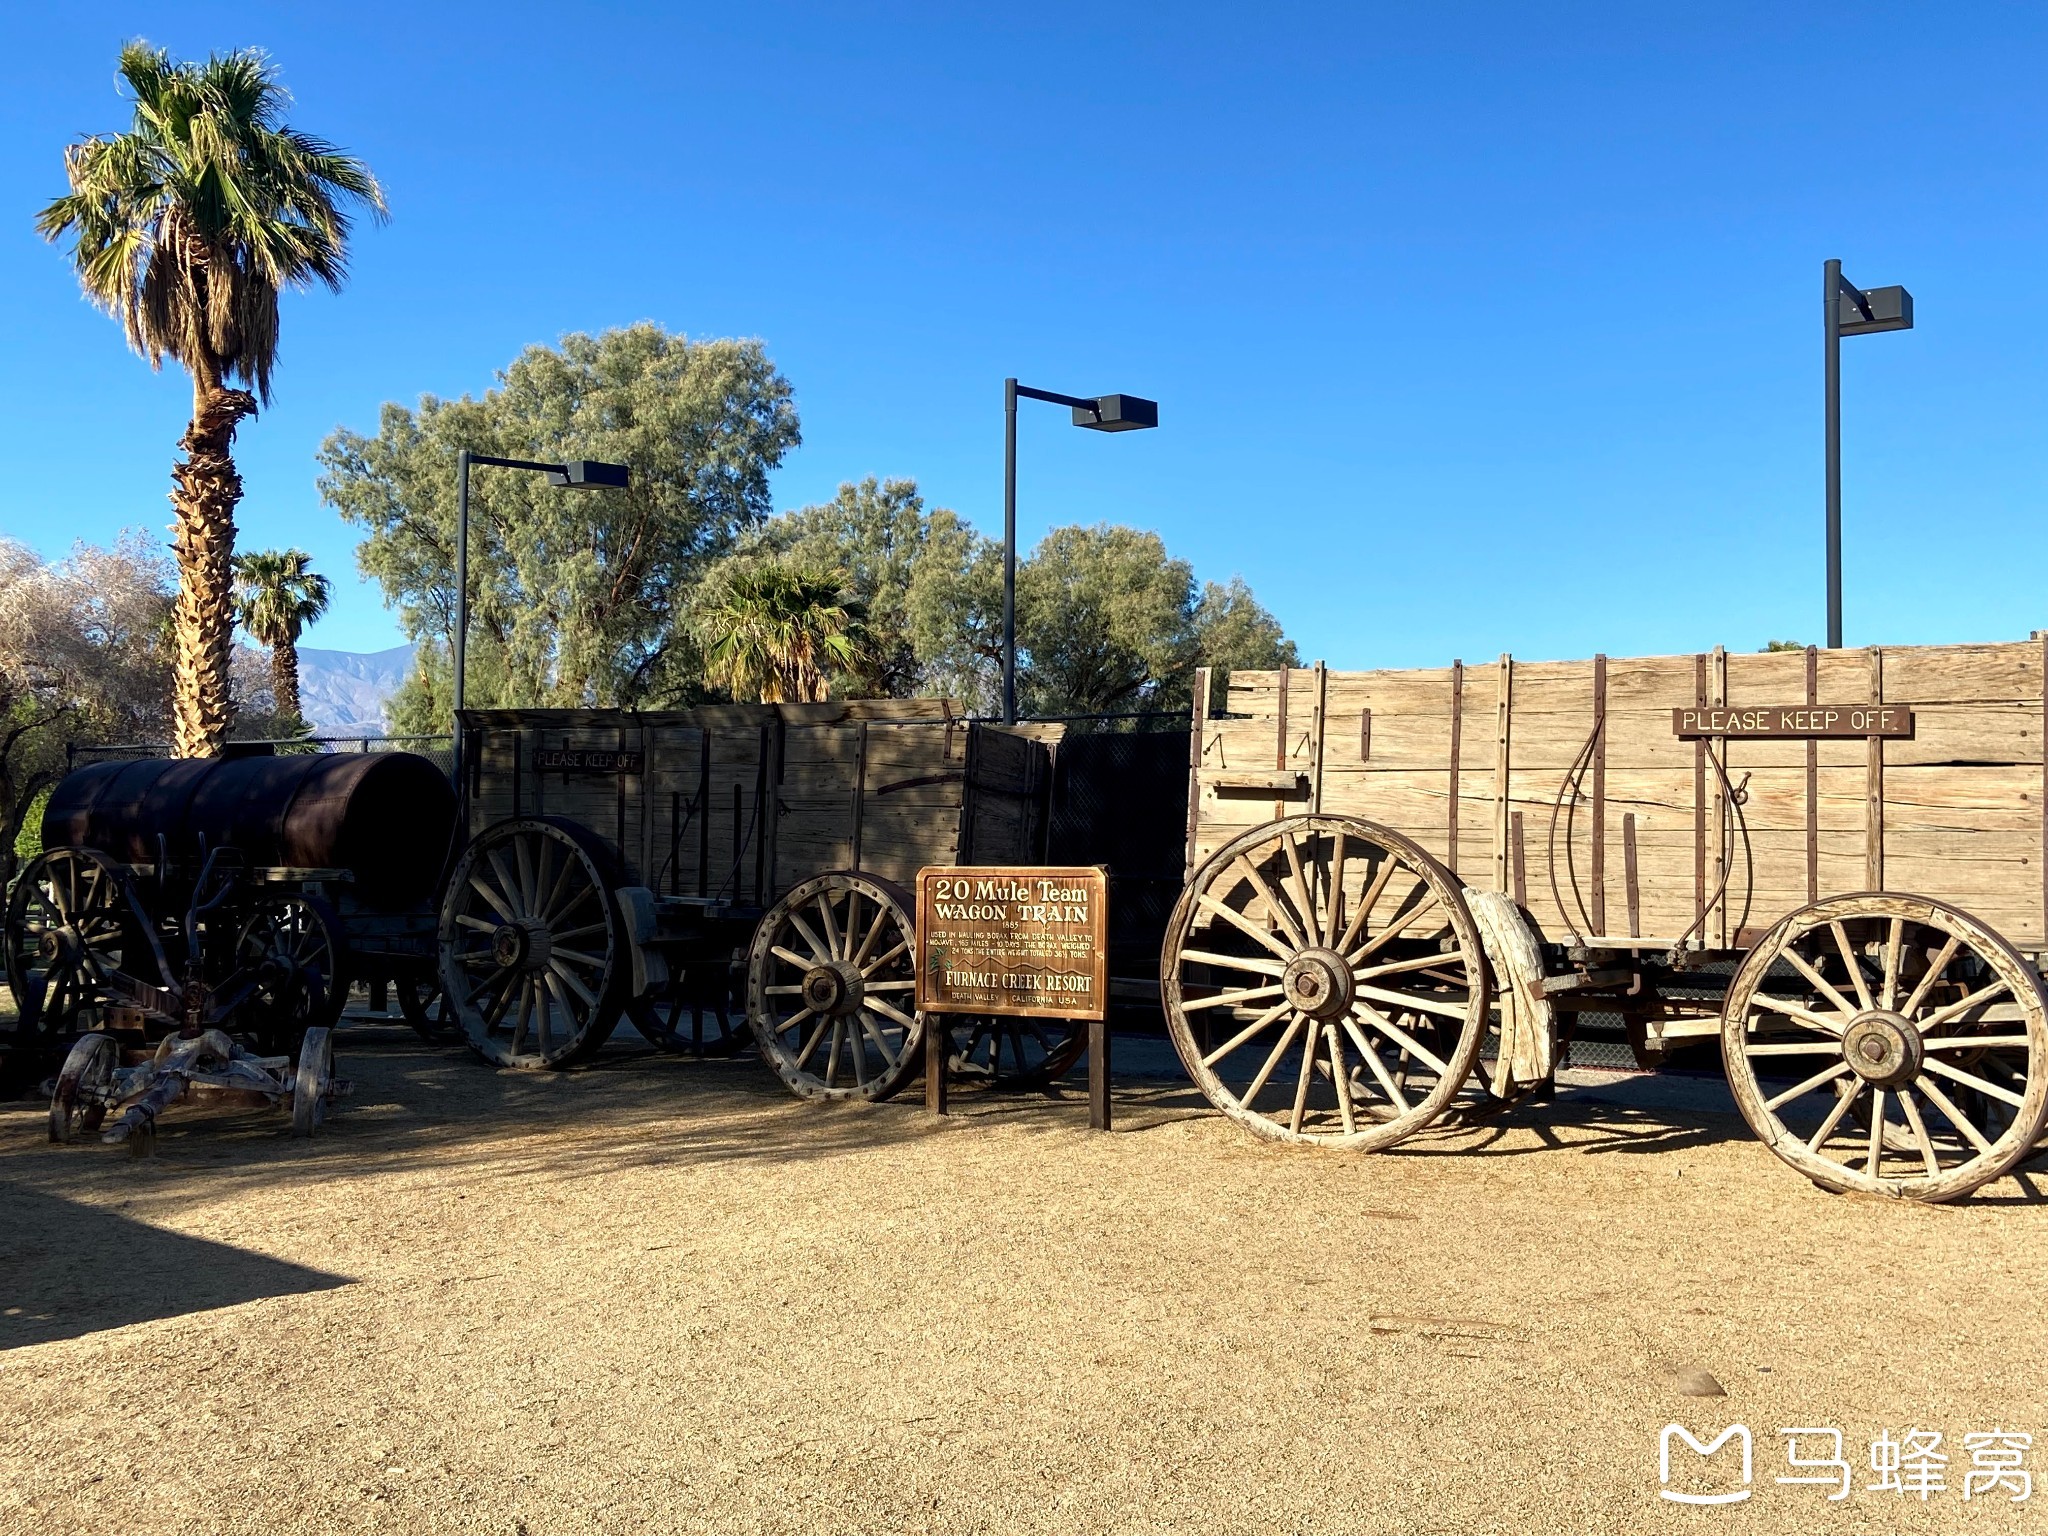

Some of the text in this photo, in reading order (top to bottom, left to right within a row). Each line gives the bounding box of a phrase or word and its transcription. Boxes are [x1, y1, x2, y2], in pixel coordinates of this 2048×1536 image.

[1683, 711, 1895, 730] PLEASE KEEP OFF
[538, 752, 636, 768] PLEASE KEEP OFF
[936, 880, 1088, 903] 20 Mule Team
[935, 904, 1088, 930] WAGON TRAIN
[1002, 921, 1019, 929] 1885
[986, 949, 1005, 957] ENTIRE
[946, 971, 1092, 992] FURNACE CREEK RESORT
[1012, 995, 1053, 1005] CALIFORNIA
